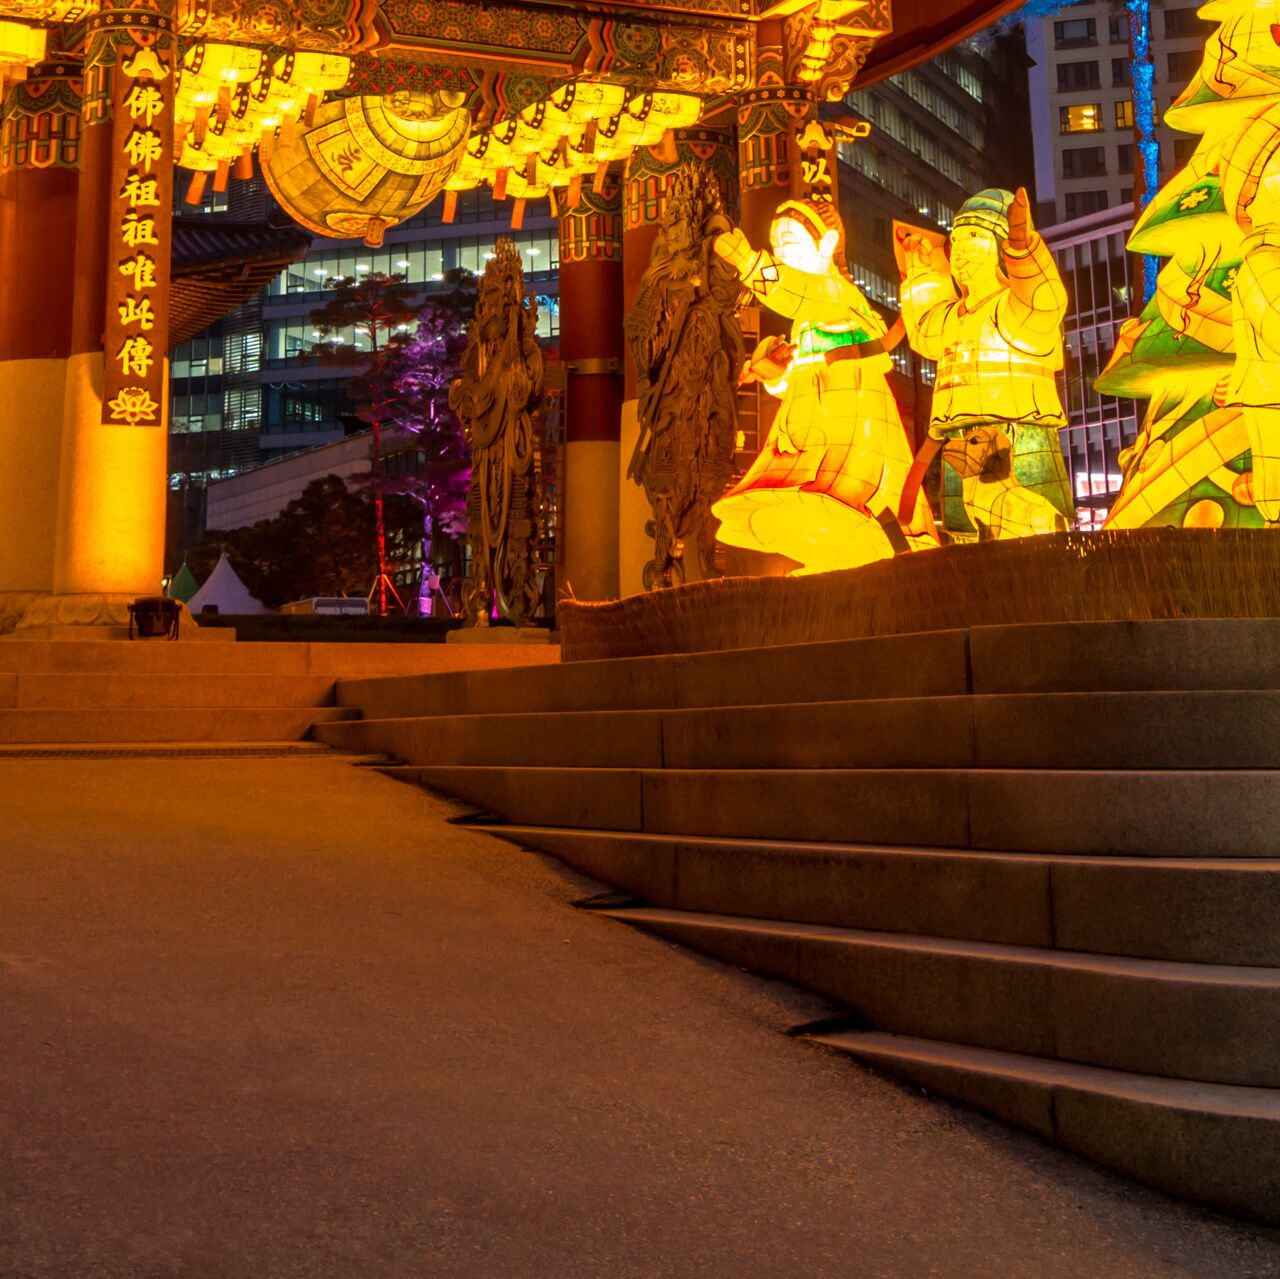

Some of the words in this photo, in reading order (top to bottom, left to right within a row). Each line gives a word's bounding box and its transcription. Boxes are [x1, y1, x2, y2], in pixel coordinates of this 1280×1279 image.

[116, 86, 164, 378] 佛佛祖祖唯此傳
